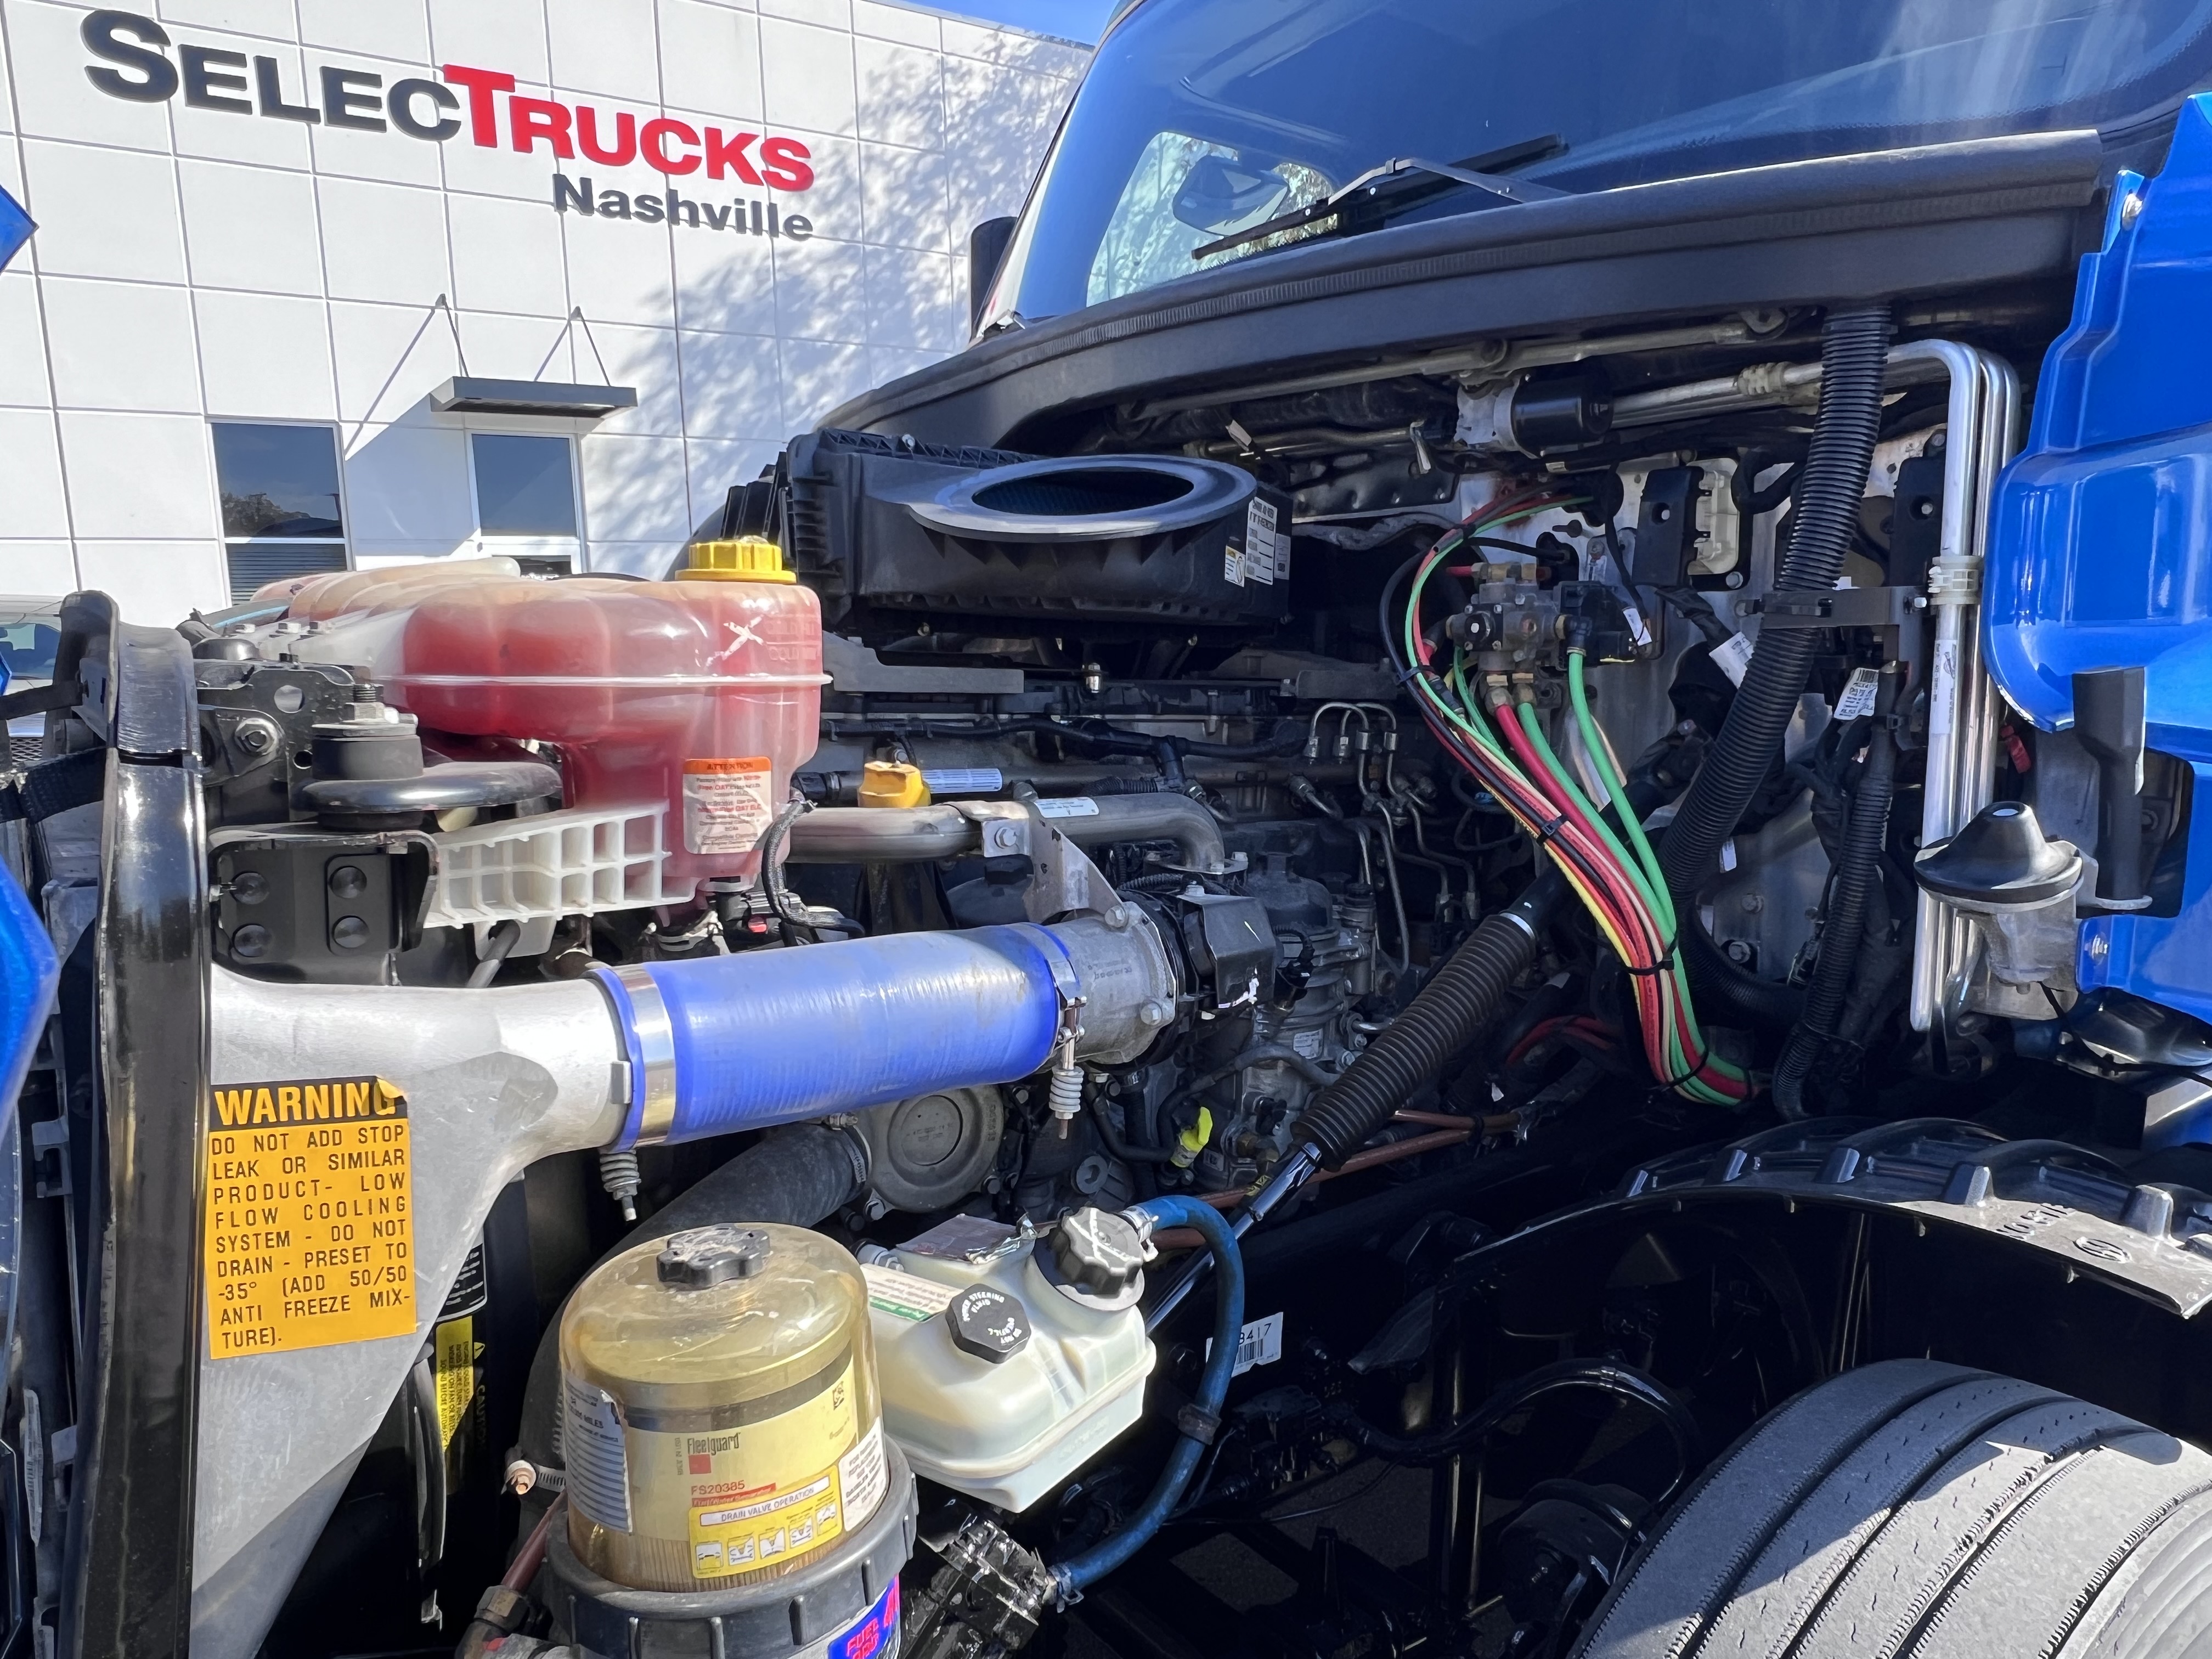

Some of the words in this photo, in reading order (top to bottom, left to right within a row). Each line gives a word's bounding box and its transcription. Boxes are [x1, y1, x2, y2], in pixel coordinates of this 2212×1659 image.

[553, 173, 814, 241] Nashville
[215, 1081, 396, 1126] WARNING
[212, 1137, 235, 1155] DO
[254, 1133, 290, 1152] NOT
[307, 1129, 342, 1148] ADD
[358, 1125, 404, 1144] STOP
[213, 1160, 259, 1180] LEAK
[282, 1156, 306, 1175] OR
[328, 1148, 404, 1171] SIMILAR
[362, 1172, 405, 1192] LOW
[216, 1207, 279, 1229] FLOW
[303, 1196, 405, 1221] COOLING
[216, 1231, 290, 1254] SYSTEM
[331, 1224, 353, 1242] DO
[373, 1219, 405, 1238] NOT
[218, 1256, 272, 1277] DRAIN
[305, 1246, 370, 1268] PRESET
[386, 1242, 407, 1259] TO
[283, 1274, 325, 1297] (ADD
[351, 1265, 406, 1287] 50/50
[221, 1305, 262, 1326] ANTI
[285, 1295, 351, 1318] FREEZE
[370, 1288, 410, 1308] MIX-
[687, 1432, 740, 1456] Fleetguard
[721, 1510, 746, 1522] DRAIN
[748, 1503, 772, 1516] VALVE
[774, 1487, 815, 1508] OPERATION
